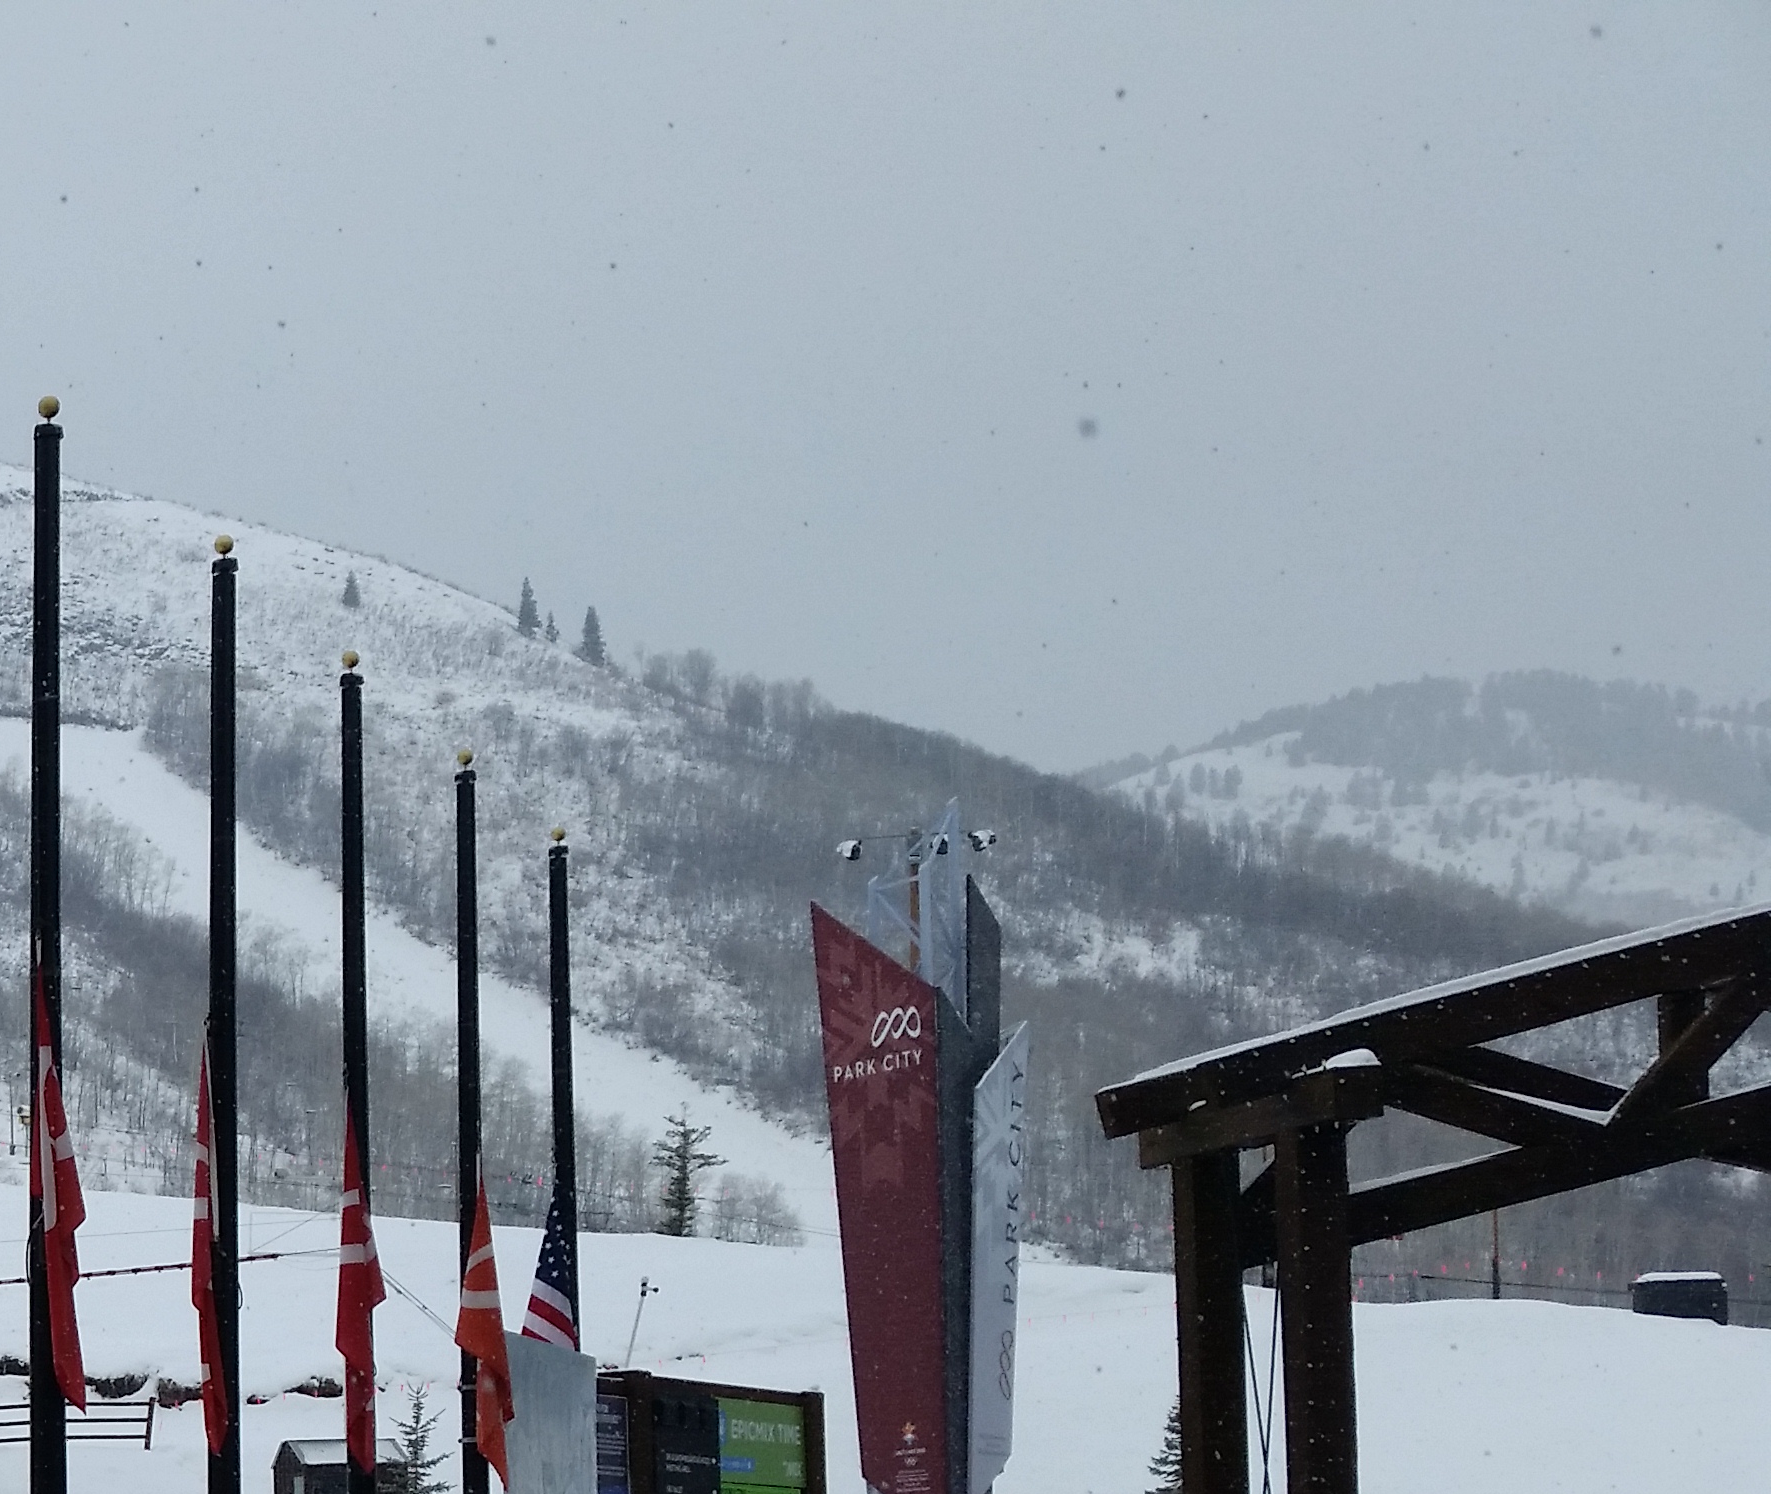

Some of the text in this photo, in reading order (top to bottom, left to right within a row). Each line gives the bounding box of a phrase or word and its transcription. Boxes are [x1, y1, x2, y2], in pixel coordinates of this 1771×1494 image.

[834, 1049, 922, 1083] PARK CITY
[1003, 1061, 1024, 1305] PARK CITY
